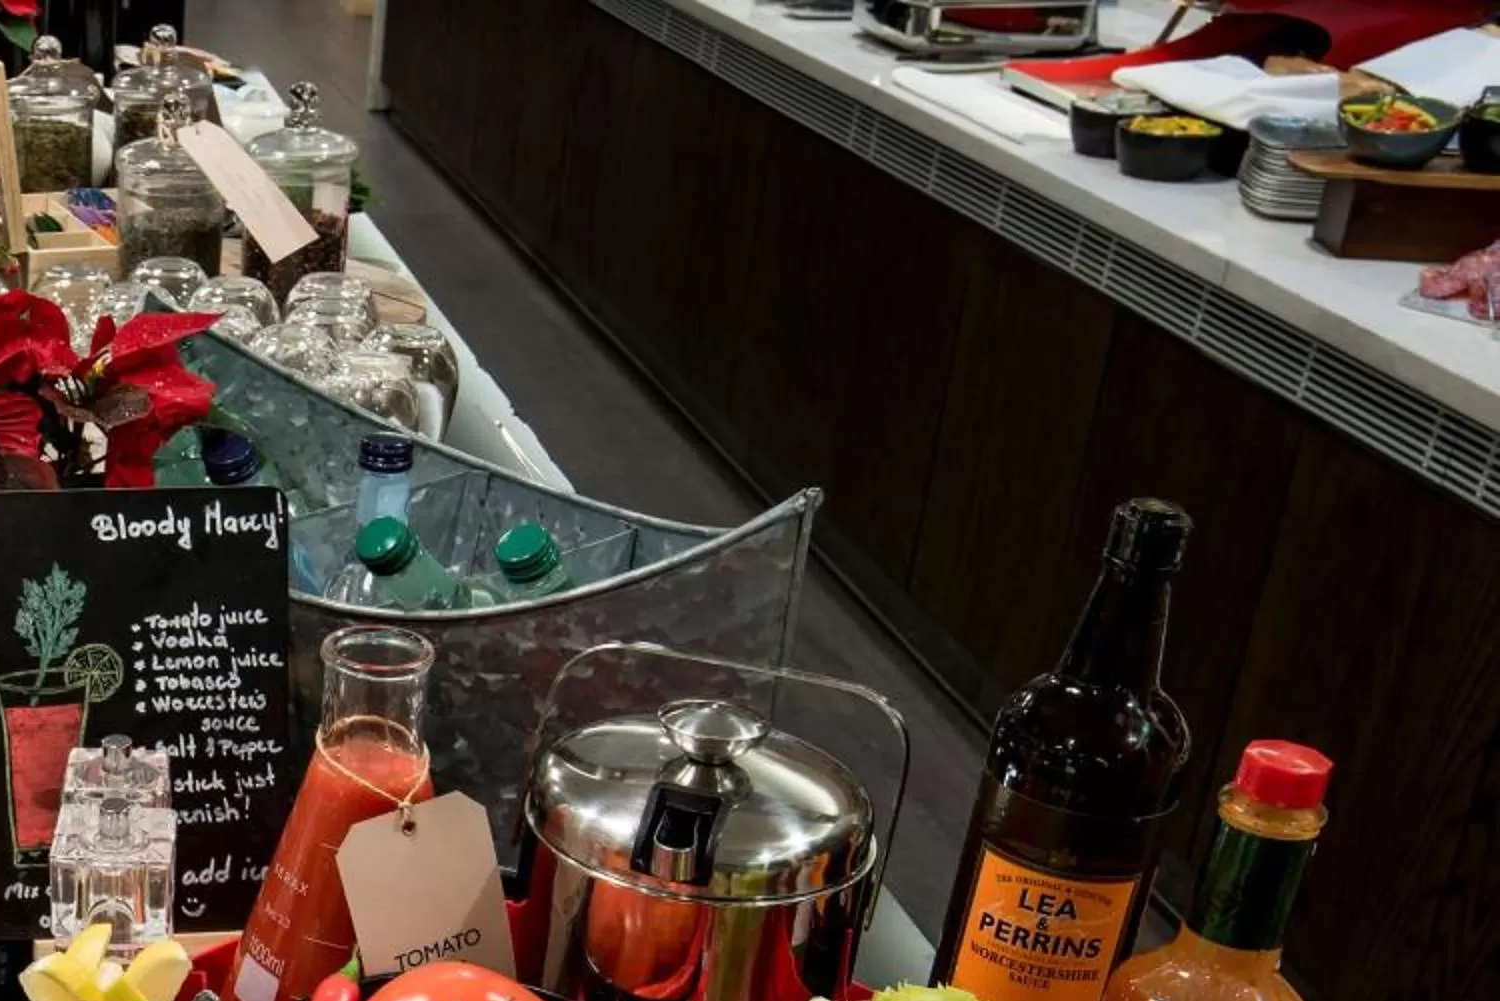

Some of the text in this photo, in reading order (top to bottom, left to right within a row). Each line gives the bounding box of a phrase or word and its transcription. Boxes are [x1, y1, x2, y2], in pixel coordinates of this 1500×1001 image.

[91, 505, 192, 550] Bloody
[144, 600, 269, 634] Tomato juice
[150, 628, 229, 648] Vodka
[151, 647, 285, 677] Lemon juice
[173, 761, 275, 798] stick just
[182, 854, 232, 886] add
[1018, 887, 1077, 921] LEA
[979, 911, 1103, 959] PERRINS
[1036, 916, 1050, 931] &
[393, 927, 482, 973] TOMATO
[970, 939, 1099, 982] WORCESTERSHIRE
[1010, 970, 1050, 990] SAUCE
